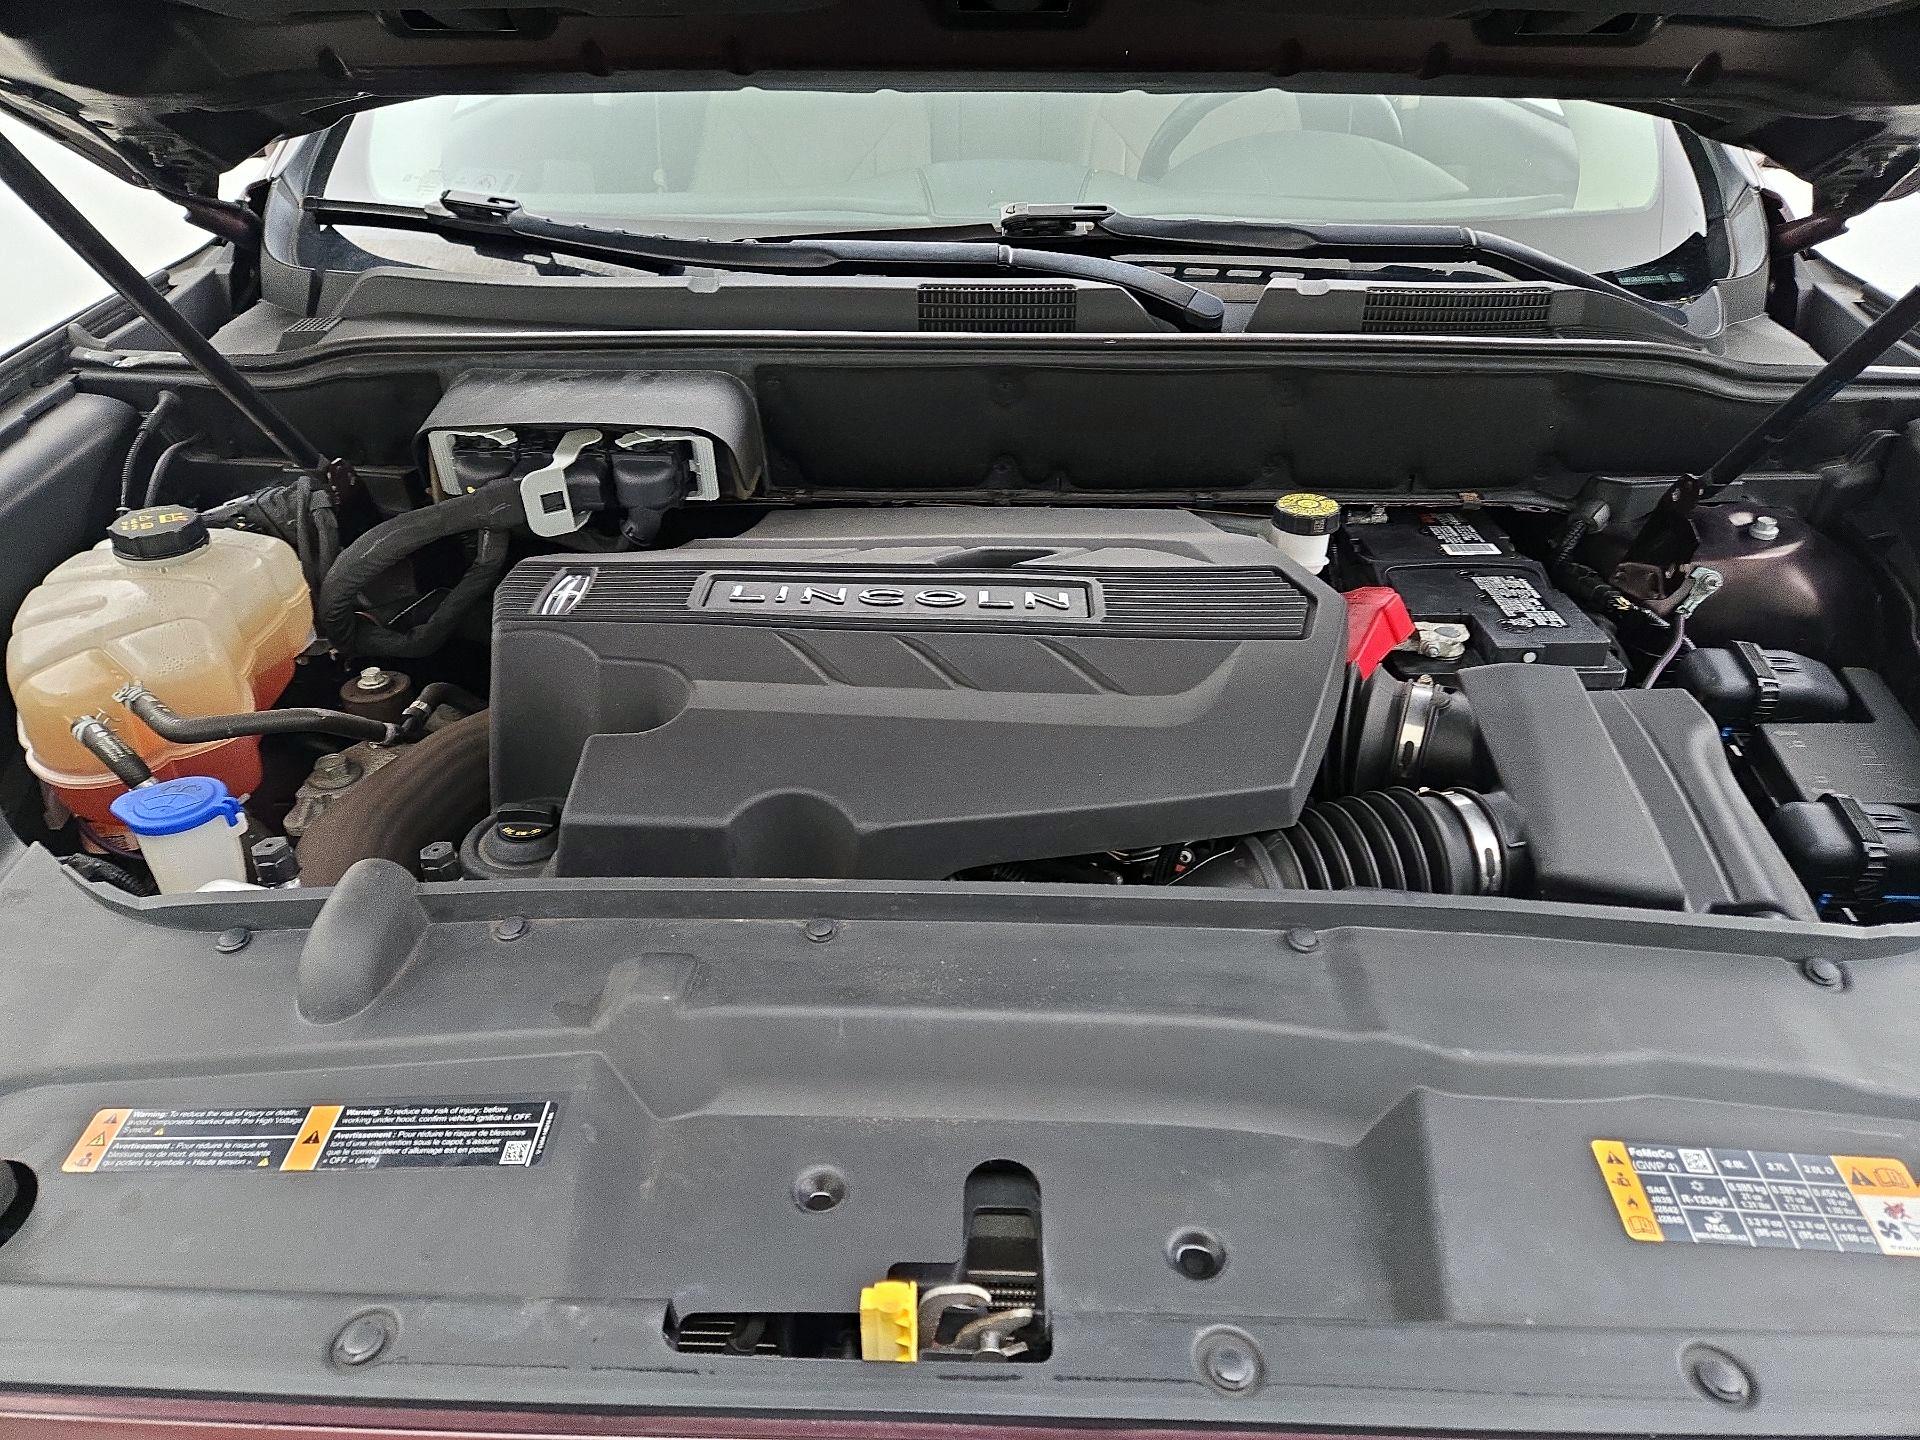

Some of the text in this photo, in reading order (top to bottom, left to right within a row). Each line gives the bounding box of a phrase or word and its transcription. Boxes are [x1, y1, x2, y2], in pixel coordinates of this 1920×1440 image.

[729, 584, 1071, 610] LINCOLN
[341, 1117, 372, 1125] working
[475, 1114, 503, 1122] ignition
[453, 1130, 477, 1138] risque
[468, 1146, 499, 1154] position
[1629, 1148, 1674, 1158] FoMoCo
